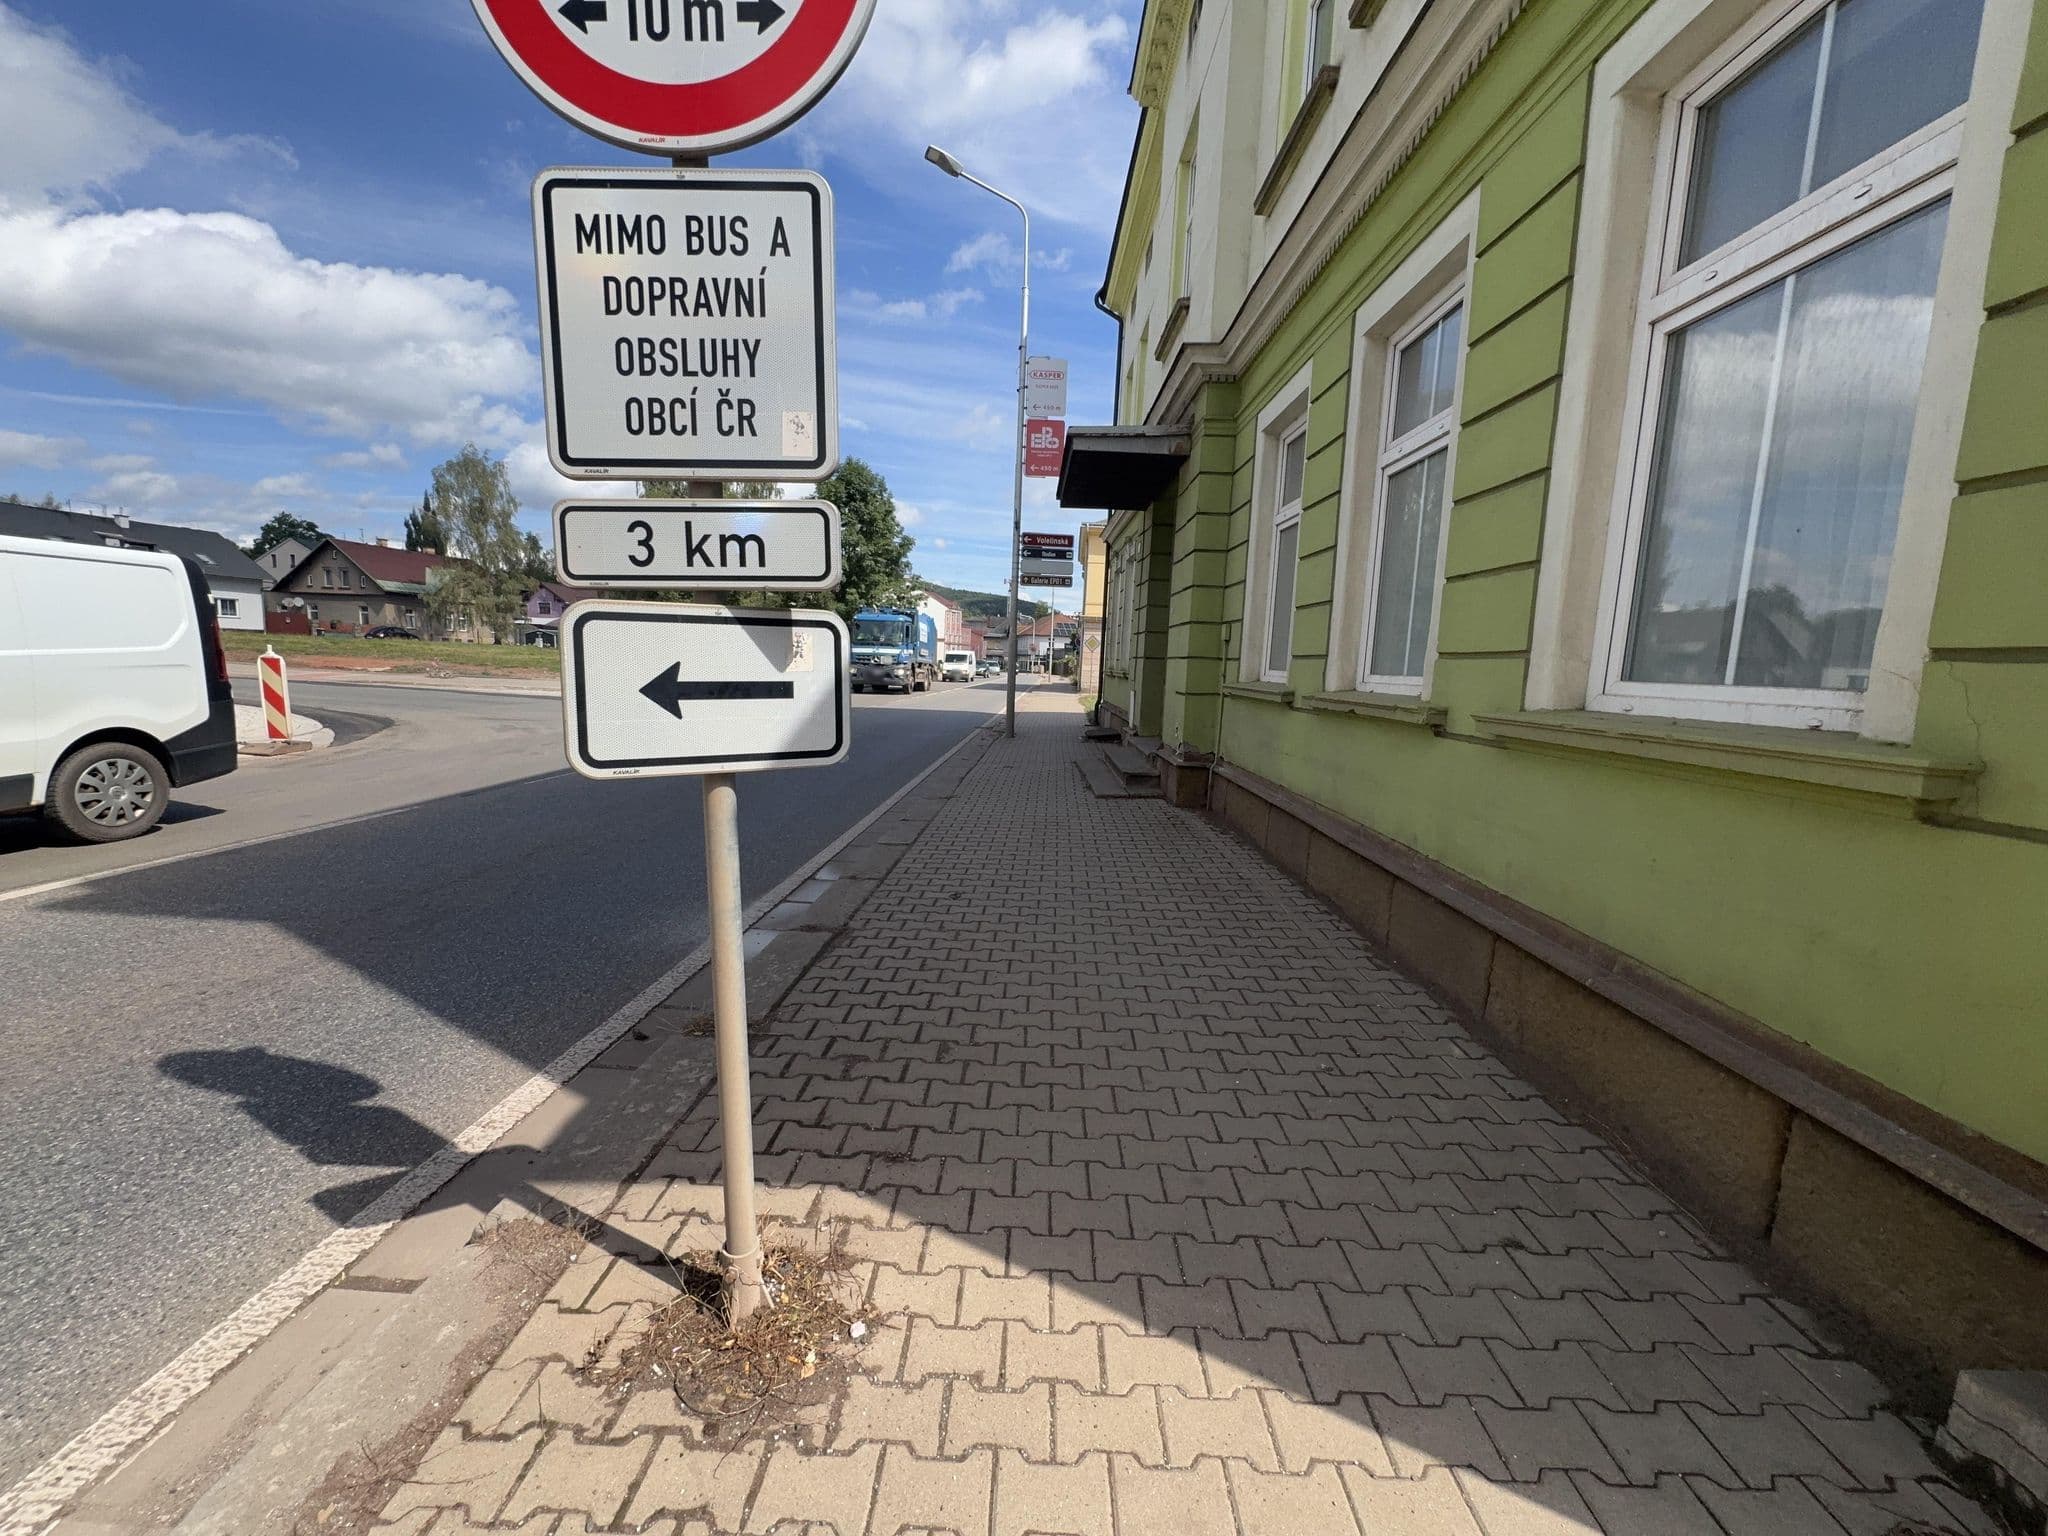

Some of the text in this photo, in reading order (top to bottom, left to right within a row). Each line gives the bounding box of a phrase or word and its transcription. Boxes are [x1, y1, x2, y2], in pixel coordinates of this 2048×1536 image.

[627, 0, 725, 42] 10 m
[574, 213, 791, 257] MIMO BUS A
[602, 266, 767, 318] DOPRAVNÍ
[614, 336, 762, 378] OBSLUHY
[624, 386, 758, 437] OBCÍ ČR
[627, 519, 766, 568] 3 km
